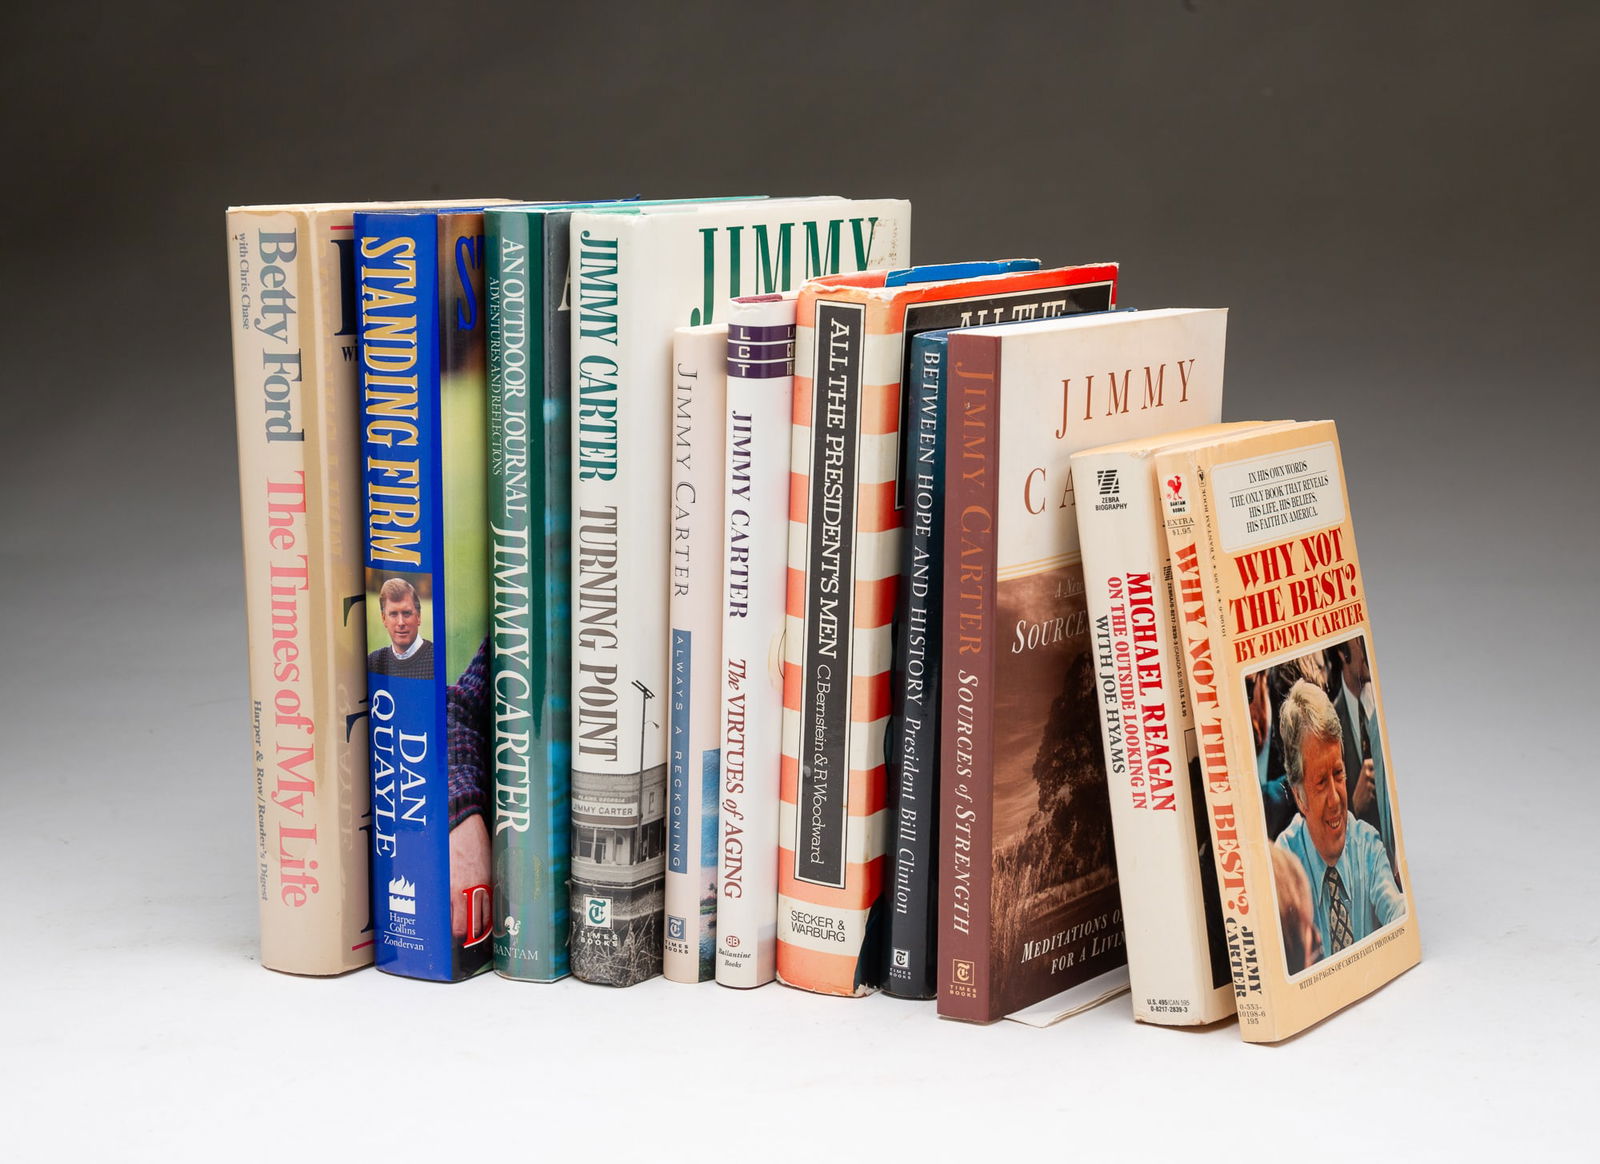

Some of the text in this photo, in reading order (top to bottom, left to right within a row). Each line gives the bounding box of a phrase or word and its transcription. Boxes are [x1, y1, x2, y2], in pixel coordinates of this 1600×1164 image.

[238, 232, 252, 330] with Chris Chase
[579, 230, 619, 347] JIMMY
[254, 228, 305, 443] Betty Ford
[829, 317, 850, 372] ALL
[360, 236, 422, 567] STANDING FIRM
[488, 277, 503, 476] ADVENTURES AND REFLECTIONS
[826, 374, 848, 428] THE
[1055, 358, 1195, 439] JIMMY
[578, 354, 619, 482] CARTER
[674, 362, 698, 598] JIMMY CARTER
[1101, 496, 1120, 504] ZEBRA
[1230, 474, 1330, 508] THE ONLY BOOK THAT REVEALS
[1248, 460, 1308, 484] IN HIS OWN WORDS
[728, 410, 753, 619] JIMMY CARTER
[819, 434, 845, 594] PRESIDENT'S
[1095, 503, 1128, 511] BIOGRAPHY
[1167, 517, 1195, 527] EXTRA
[1172, 527, 1192, 536] $1.95
[1246, 519, 1260, 534] HIS
[1259, 514, 1281, 531] FAITH
[1280, 513, 1289, 525] IN
[1248, 505, 1262, 519] HIS
[1279, 498, 1292, 512] HIS
[489, 237, 532, 836] AN OUTDOOR JOURNAL JIMMY CARTER
[1234, 527, 1345, 592] WHY NOT
[578, 506, 619, 651] TURNING
[1174, 541, 1208, 629] WHY
[1229, 562, 1358, 636] THE BEST?
[817, 597, 839, 659] MEN
[896, 351, 941, 915] BETWEEN HOPE AND HISTORY President Bill Clinton
[951, 361, 994, 936] JIMMY CARTER SOURCES of STRENGTH
[1011, 609, 1090, 654] SOURCE
[1126, 571, 1163, 697] MICHAEL
[1233, 602, 1365, 664] BY JIMMY CARTER
[265, 470, 320, 908] The Times of My Life
[1095, 614, 1126, 774] WITH JOE HYAMS
[1107, 576, 1148, 810] ON THE OUTSIDE LOOKING IN
[1188, 637, 1220, 710] NOT
[252, 700, 264, 746] Harper
[578, 661, 619, 762] POINT
[255, 750, 264, 762] &
[370, 689, 397, 858] QUAYLE
[398, 730, 428, 827] DAN
[672, 635, 685, 868] ALWAYS A RECKONING
[721, 658, 746, 899] The VIRTUES of AGING
[813, 753, 828, 766] &
[1141, 702, 1177, 812] REAGAN
[1200, 717, 1232, 794] THE
[599, 806, 633, 816] CARTER
[258, 862, 269, 902] Digest
[1213, 803, 1250, 916] BEST?
[383, 934, 424, 951] Zondervan
[389, 912, 416, 926] Harper
[389, 922, 416, 936] Collins
[580, 930, 618, 941] TIMES
[580, 937, 618, 947] BOOKS
[665, 940, 689, 950] TIMES
[790, 910, 846, 931] SECKER &
[791, 922, 846, 943] WARBURG
[1020, 908, 1123, 964] MEDITATIONS O
[493, 942, 539, 961] BANTAM
[665, 946, 689, 955] BOOKS
[719, 948, 752, 959] Ballantine
[724, 959, 742, 968] Books
[889, 967, 912, 976] TIMES
[889, 972, 912, 980] BOOKS
[1050, 951, 1074, 975] FOR
[1079, 945, 1086, 963] A
[1225, 917, 1247, 998] CARTER
[1241, 925, 1263, 996] JIMMY
[949, 990, 977, 998] BOOKS
[950, 984, 976, 993] TIMES
[1246, 1017, 1260, 1025] 195
